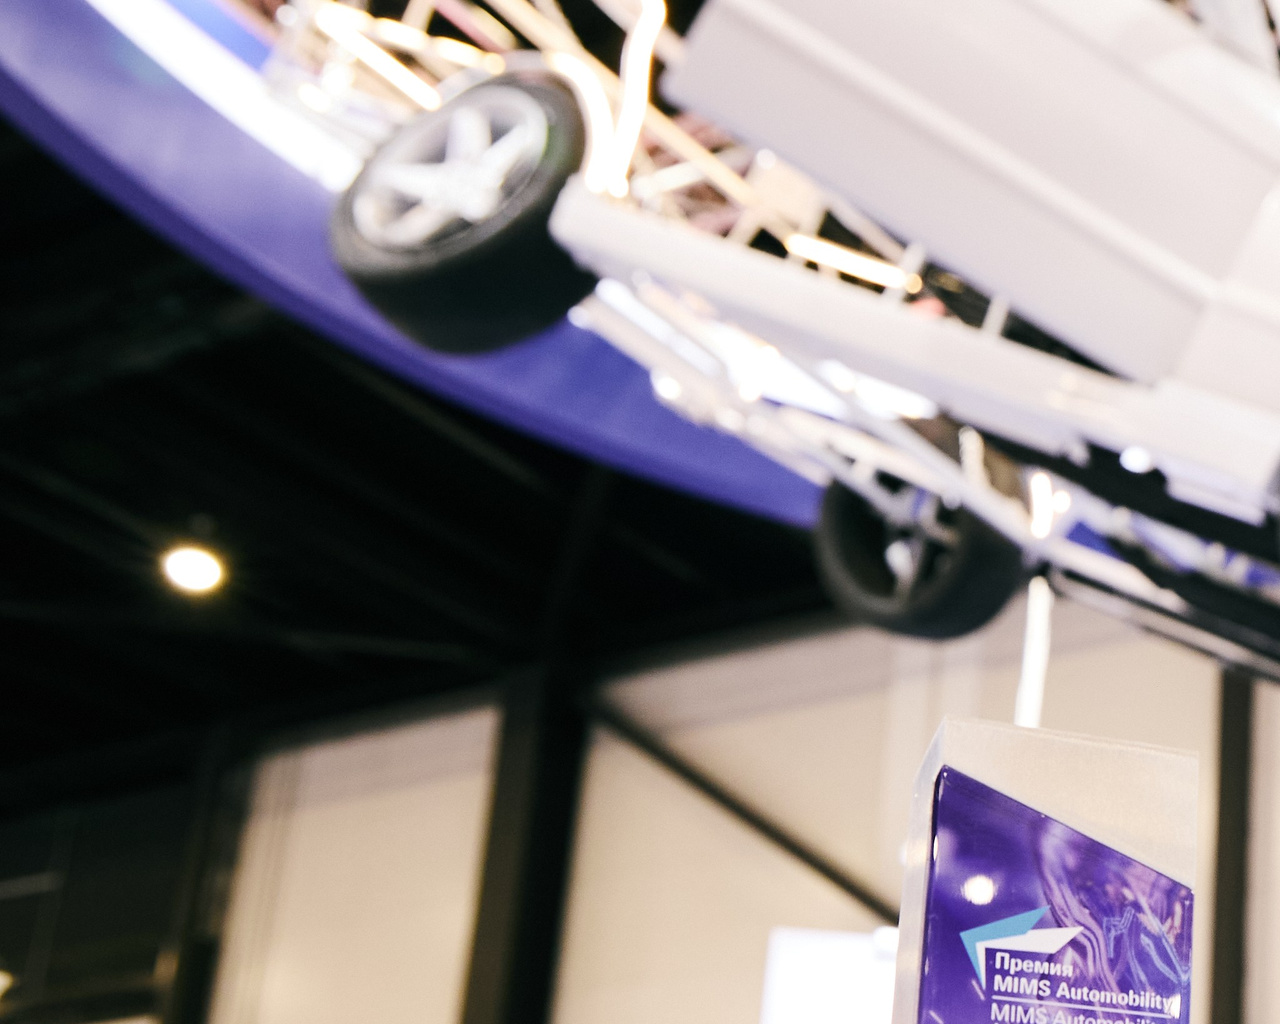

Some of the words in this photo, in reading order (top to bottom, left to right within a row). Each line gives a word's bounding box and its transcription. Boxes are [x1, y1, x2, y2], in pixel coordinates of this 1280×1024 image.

[995, 951, 1074, 977] Премия
[993, 974, 1051, 997] MIMS
[1056, 981, 1173, 1013] Automobility
